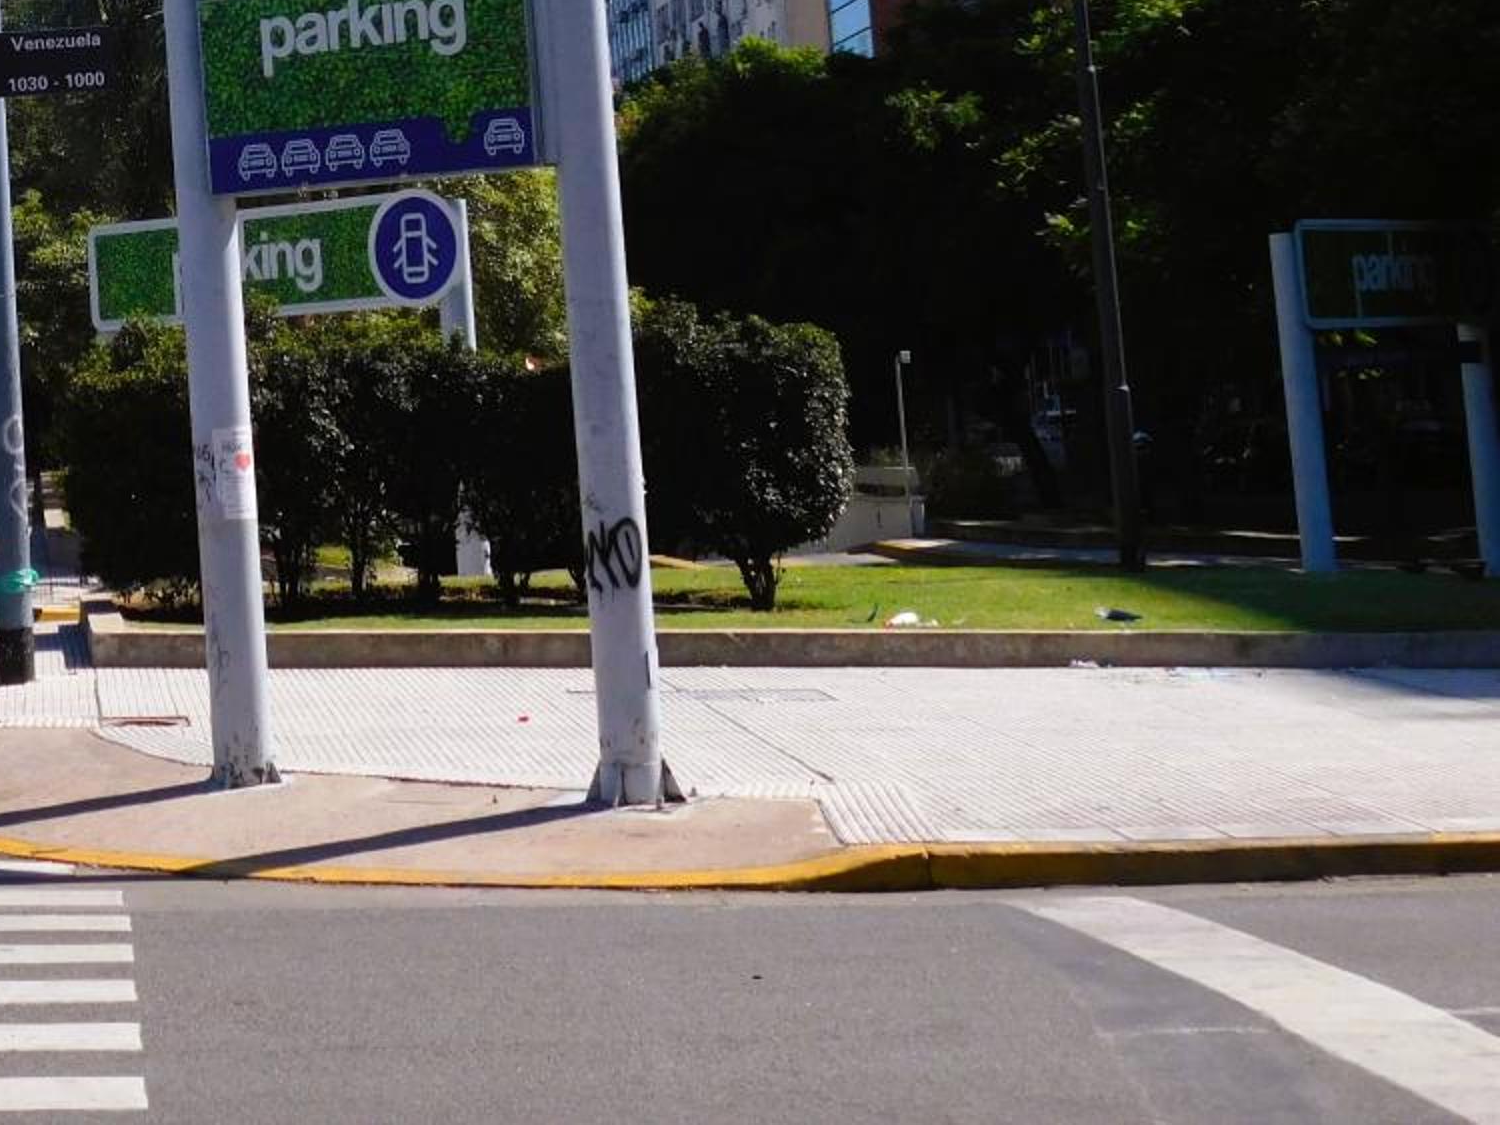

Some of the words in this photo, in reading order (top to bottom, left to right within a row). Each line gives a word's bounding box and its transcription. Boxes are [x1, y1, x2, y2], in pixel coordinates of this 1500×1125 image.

[10, 32, 101, 51] Venezuela
[8, 75, 49, 92] 1030
[65, 71, 106, 88] 1000
